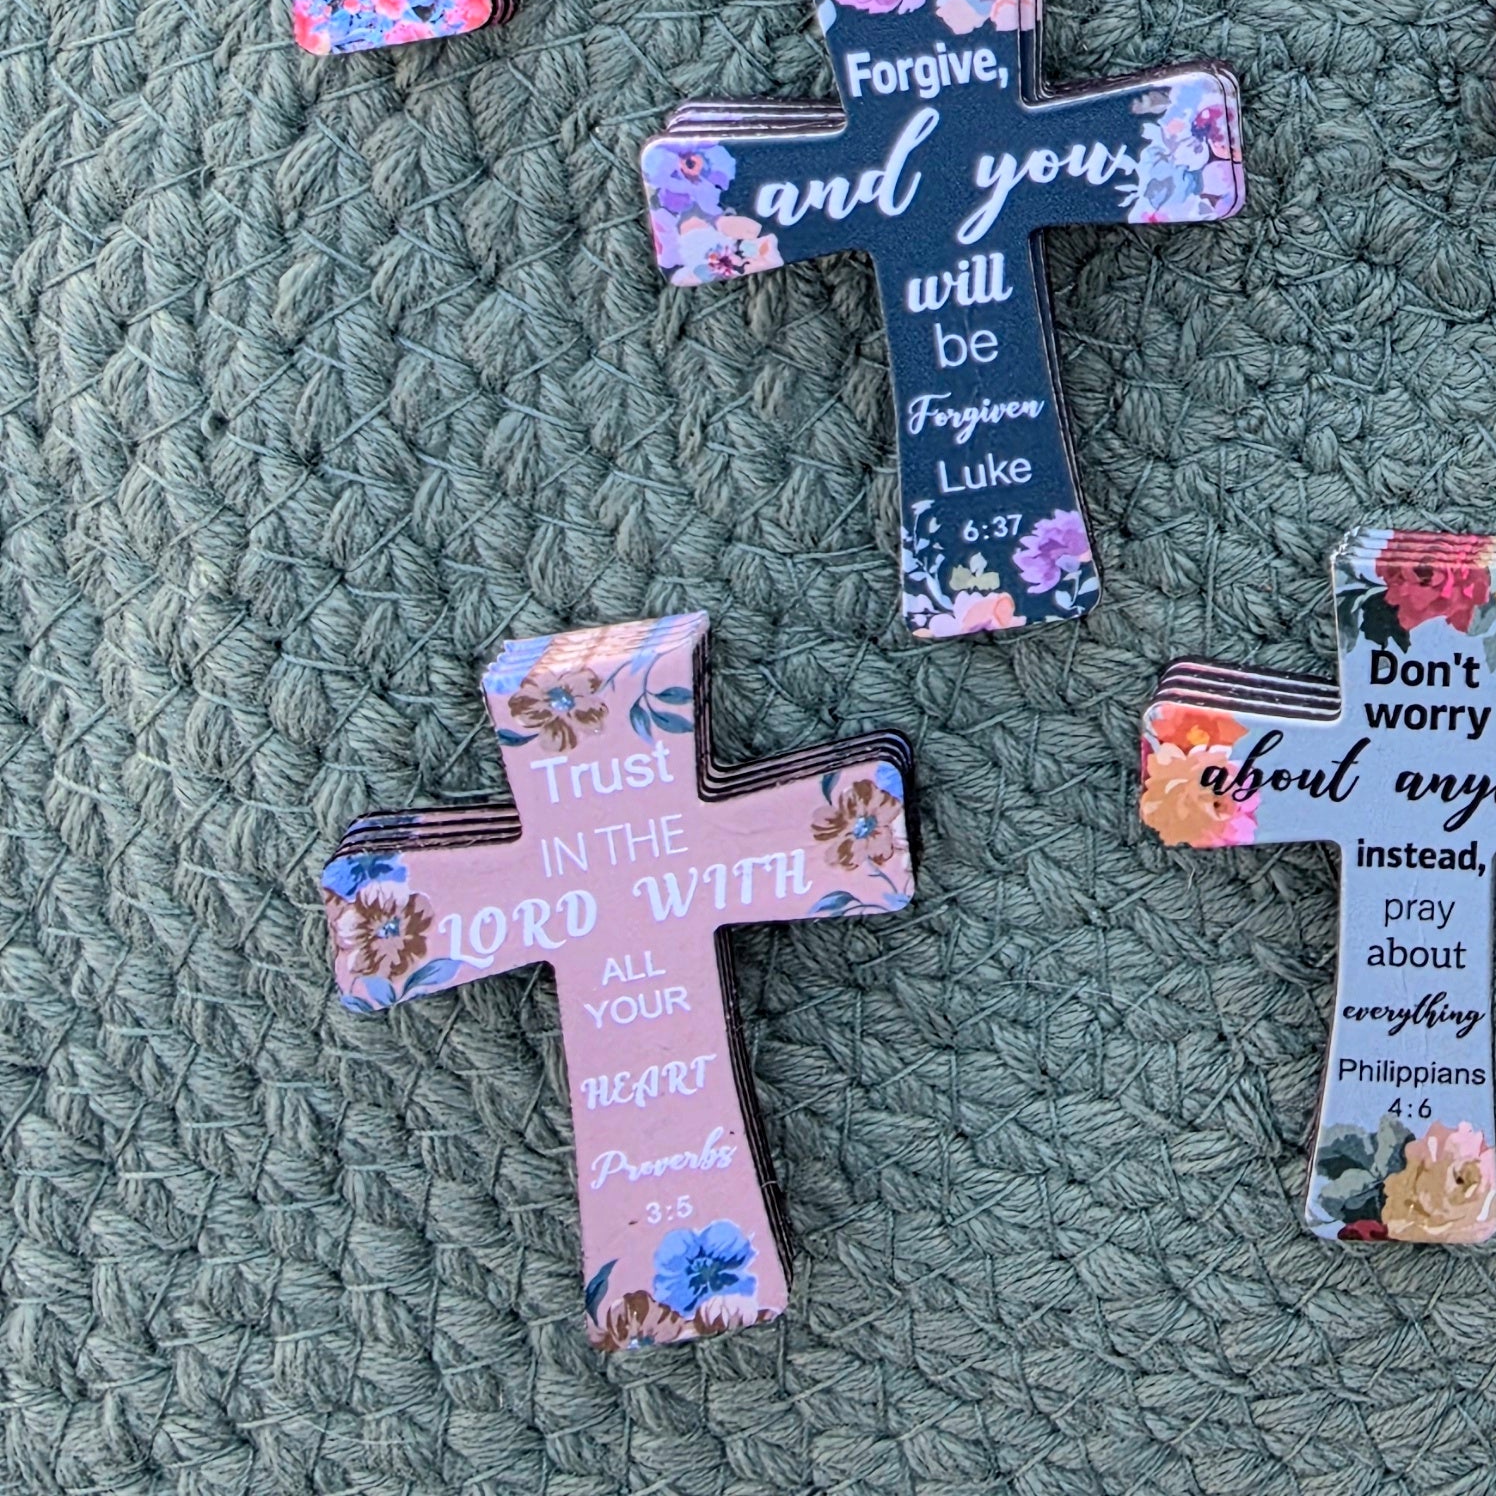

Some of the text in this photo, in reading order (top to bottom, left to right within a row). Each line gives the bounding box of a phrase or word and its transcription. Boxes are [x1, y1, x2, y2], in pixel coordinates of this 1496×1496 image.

[846, 43, 1009, 98] Forgive,
[755, 107, 1128, 246] and you
[906, 253, 1014, 313] will
[933, 322, 1000, 368] be
[907, 393, 1045, 443] Forgiven
[937, 453, 1033, 493] Luke
[963, 513, 1024, 543] 6:37
[1370, 650, 1480, 689] Don't
[1366, 700, 1491, 740] worry
[530, 740, 675, 805] Trust
[1200, 730, 1372, 802] about
[541, 813, 689, 879] IN THE
[1356, 839, 1487, 877] instead,
[438, 848, 813, 968] LORD WITH
[1383, 894, 1455, 926] pray
[601, 950, 666, 986] ALL
[1367, 938, 1467, 970] about
[583, 986, 691, 1030] YOUR
[1342, 991, 1486, 1038] everything
[581, 1054, 717, 1111] HEART
[1337, 1059, 1487, 1088] Philippians
[1388, 1099, 1432, 1120] 4:6
[590, 1126, 737, 1191] Proverbs
[645, 1197, 694, 1225] 3:5
